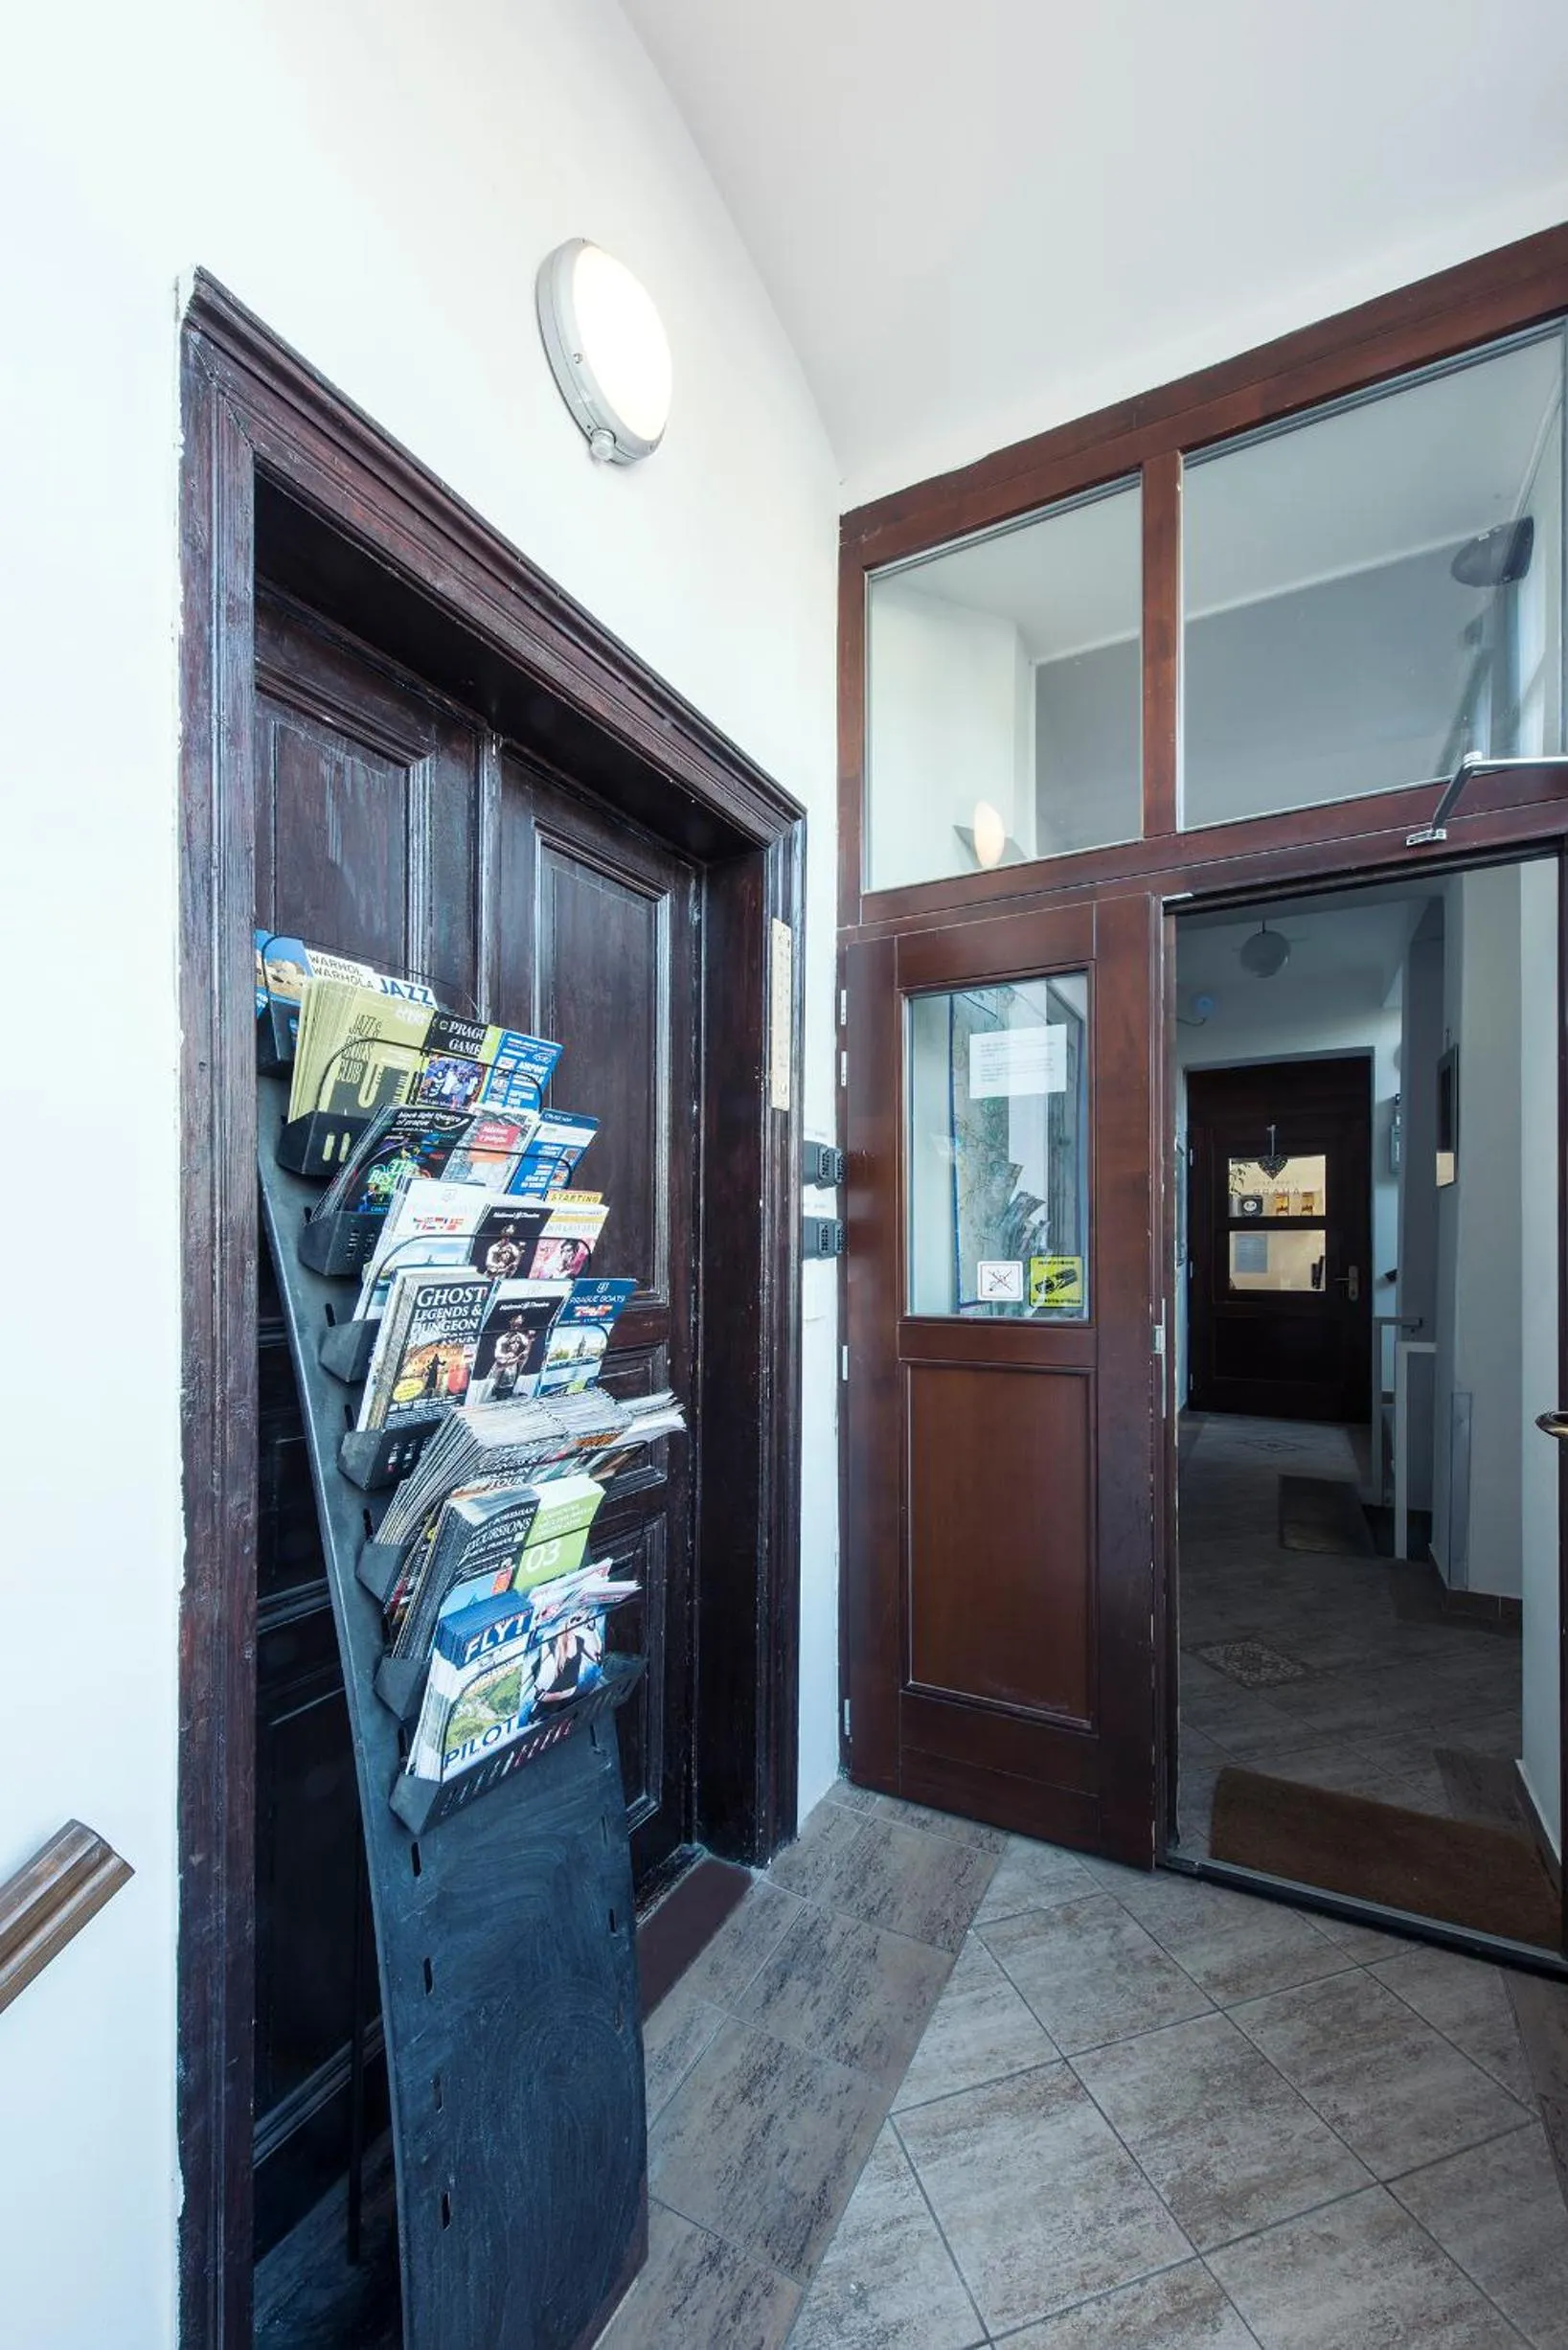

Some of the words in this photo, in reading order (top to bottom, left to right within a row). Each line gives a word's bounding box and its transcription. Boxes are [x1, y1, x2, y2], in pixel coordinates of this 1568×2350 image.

[313, 968, 375, 990] WARHOLA
[380, 978, 434, 1006] JAZZ
[337, 1060, 364, 1084] CLUB
[550, 1192, 601, 1203] STARTING
[417, 1287, 488, 1308] GHOST
[414, 1306, 469, 1322] LEGENDS
[470, 1304, 483, 1317] &
[528, 1539, 561, 1573] 03
